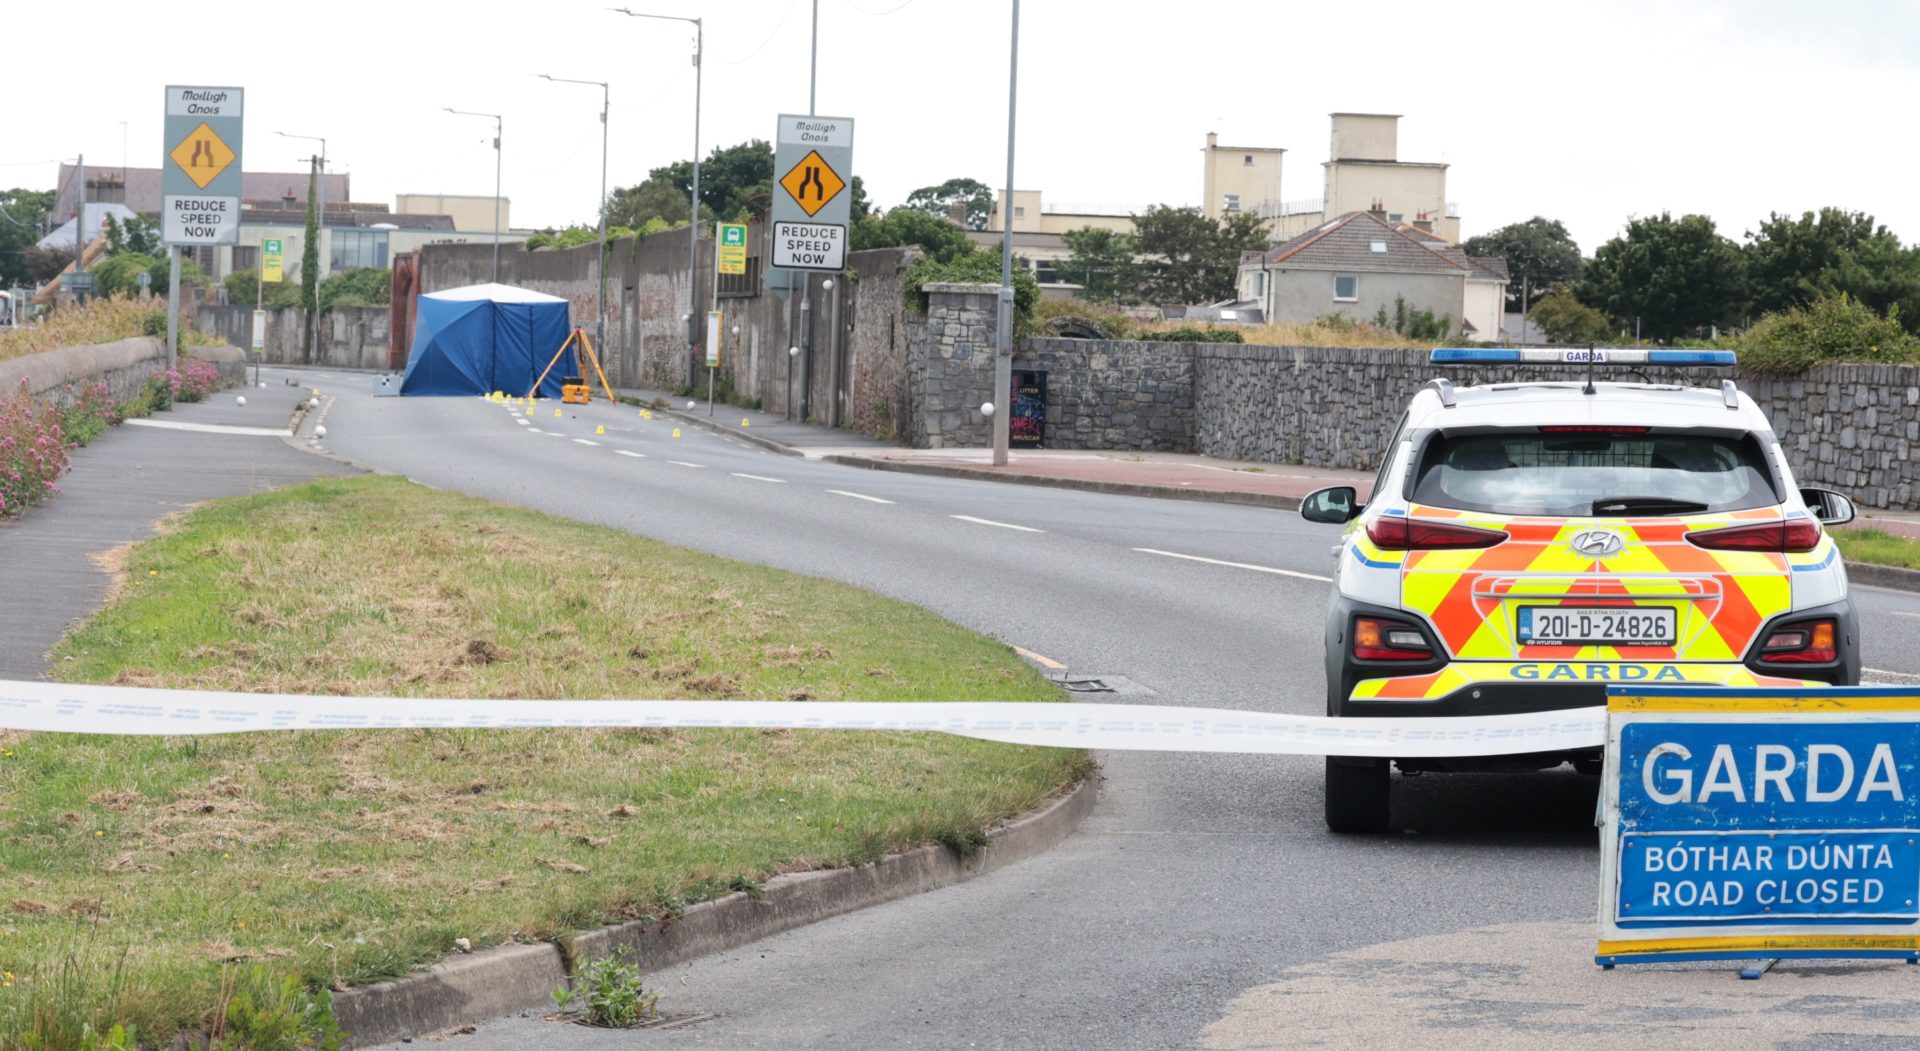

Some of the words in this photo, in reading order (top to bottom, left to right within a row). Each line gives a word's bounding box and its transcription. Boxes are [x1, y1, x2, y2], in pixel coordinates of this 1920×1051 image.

[182, 90, 227, 103] Moilligh
[796, 121, 836, 133] Moilligh
[175, 200, 226, 212] REDUCE
[180, 213, 222, 224] SPEED
[185, 226, 216, 237] NOW
[782, 226, 837, 239] REDUCE
[787, 239, 831, 252] SPEED
[792, 253, 825, 264] NOW
[1566, 352, 1604, 361] GARDA
[1539, 615, 1667, 638] 201-D-24826
[1510, 664, 1686, 681] GARDA
[1642, 742, 1905, 805] GARDA
[1645, 841, 1773, 872] BÓTHAR
[1787, 839, 1894, 871] DÚNTA
[1652, 881, 1744, 906] ROAD
[1756, 879, 1885, 904] CLOSED
